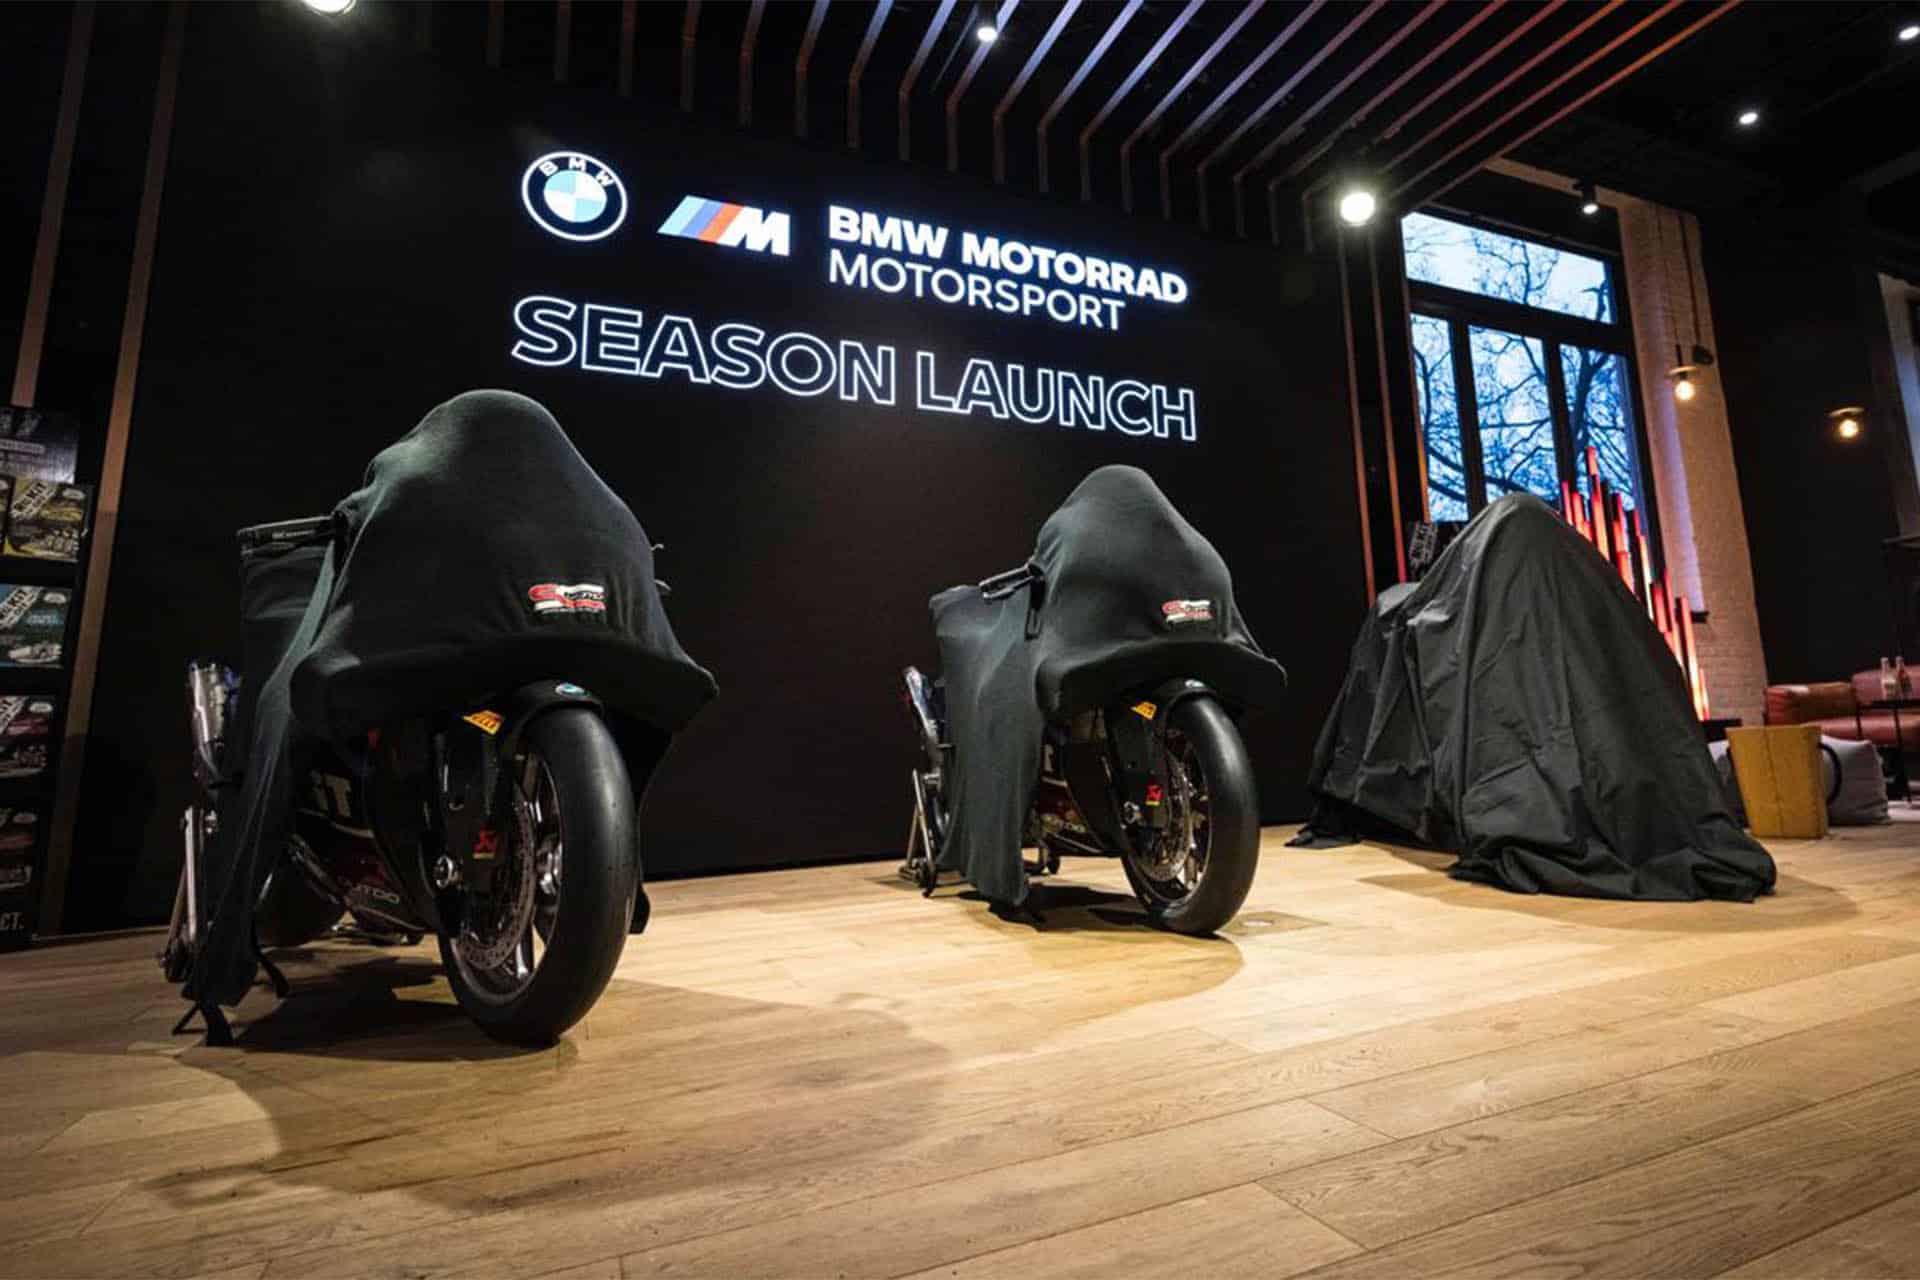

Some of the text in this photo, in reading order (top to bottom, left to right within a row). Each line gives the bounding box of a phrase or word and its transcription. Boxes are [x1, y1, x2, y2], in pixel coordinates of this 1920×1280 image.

[538, 157, 614, 188] BMW
[716, 205, 791, 256] M
[828, 204, 1188, 304] BMW MOTORRAD
[828, 248, 1126, 331] MOTORSPORT
[510, 294, 1197, 441] SEASON LAUNCH
